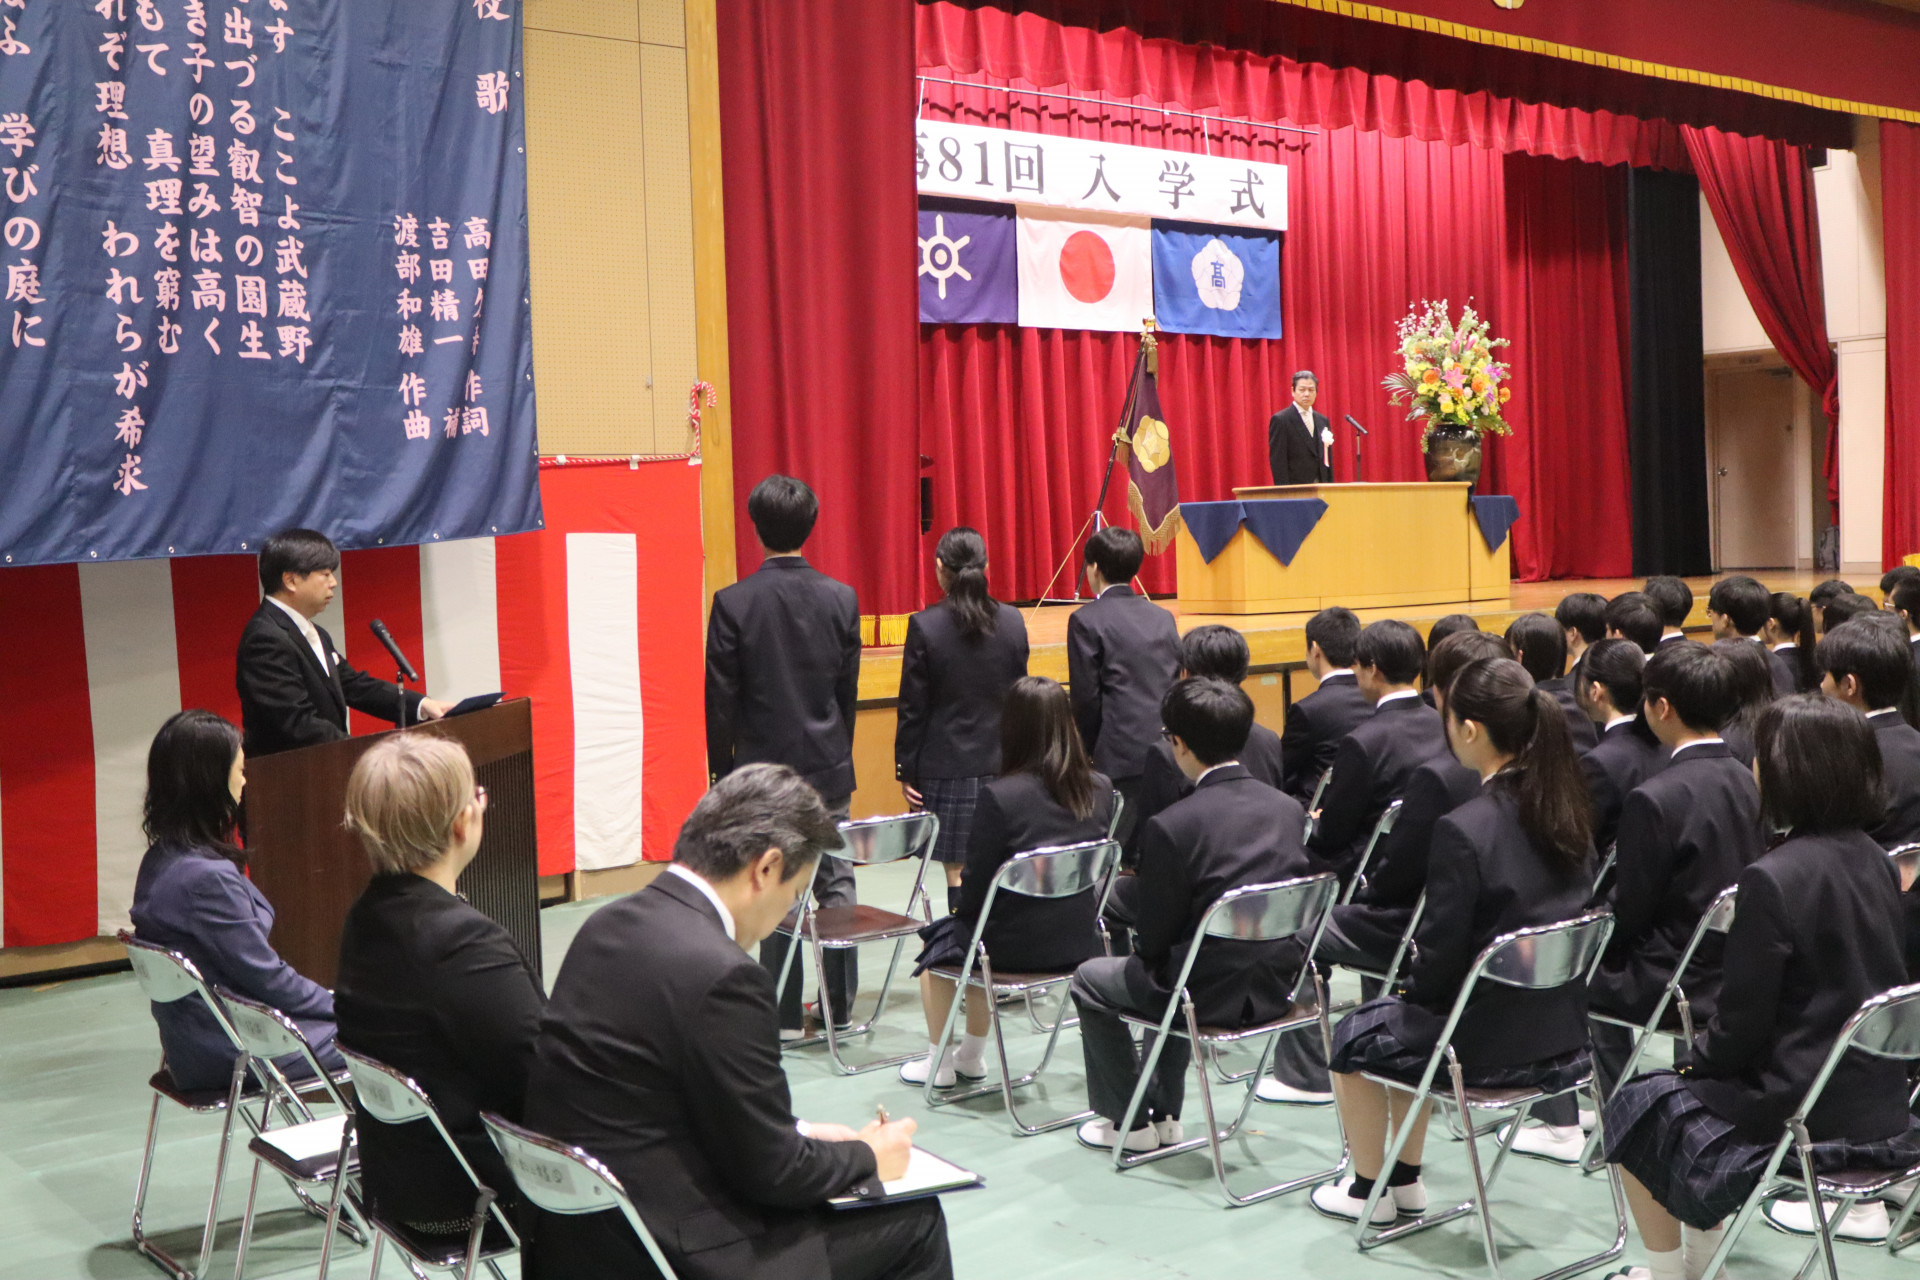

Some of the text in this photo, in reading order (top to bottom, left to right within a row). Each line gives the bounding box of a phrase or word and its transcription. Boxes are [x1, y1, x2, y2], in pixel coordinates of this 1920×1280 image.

[0, 112, 47, 349] 学びの庭に
[142, 127, 184, 355] 真理を窮む
[182, 0, 227, 355] き子の望みは高く
[223, 0, 272, 361] 出づる叡智の園生
[264, 0, 314, 364] す ここよ武蔵野
[427, 215, 465, 346] 吉田精一
[101, 219, 150, 496] われらが希求
[392, 212, 431, 441] 渡部和雄 作曲
